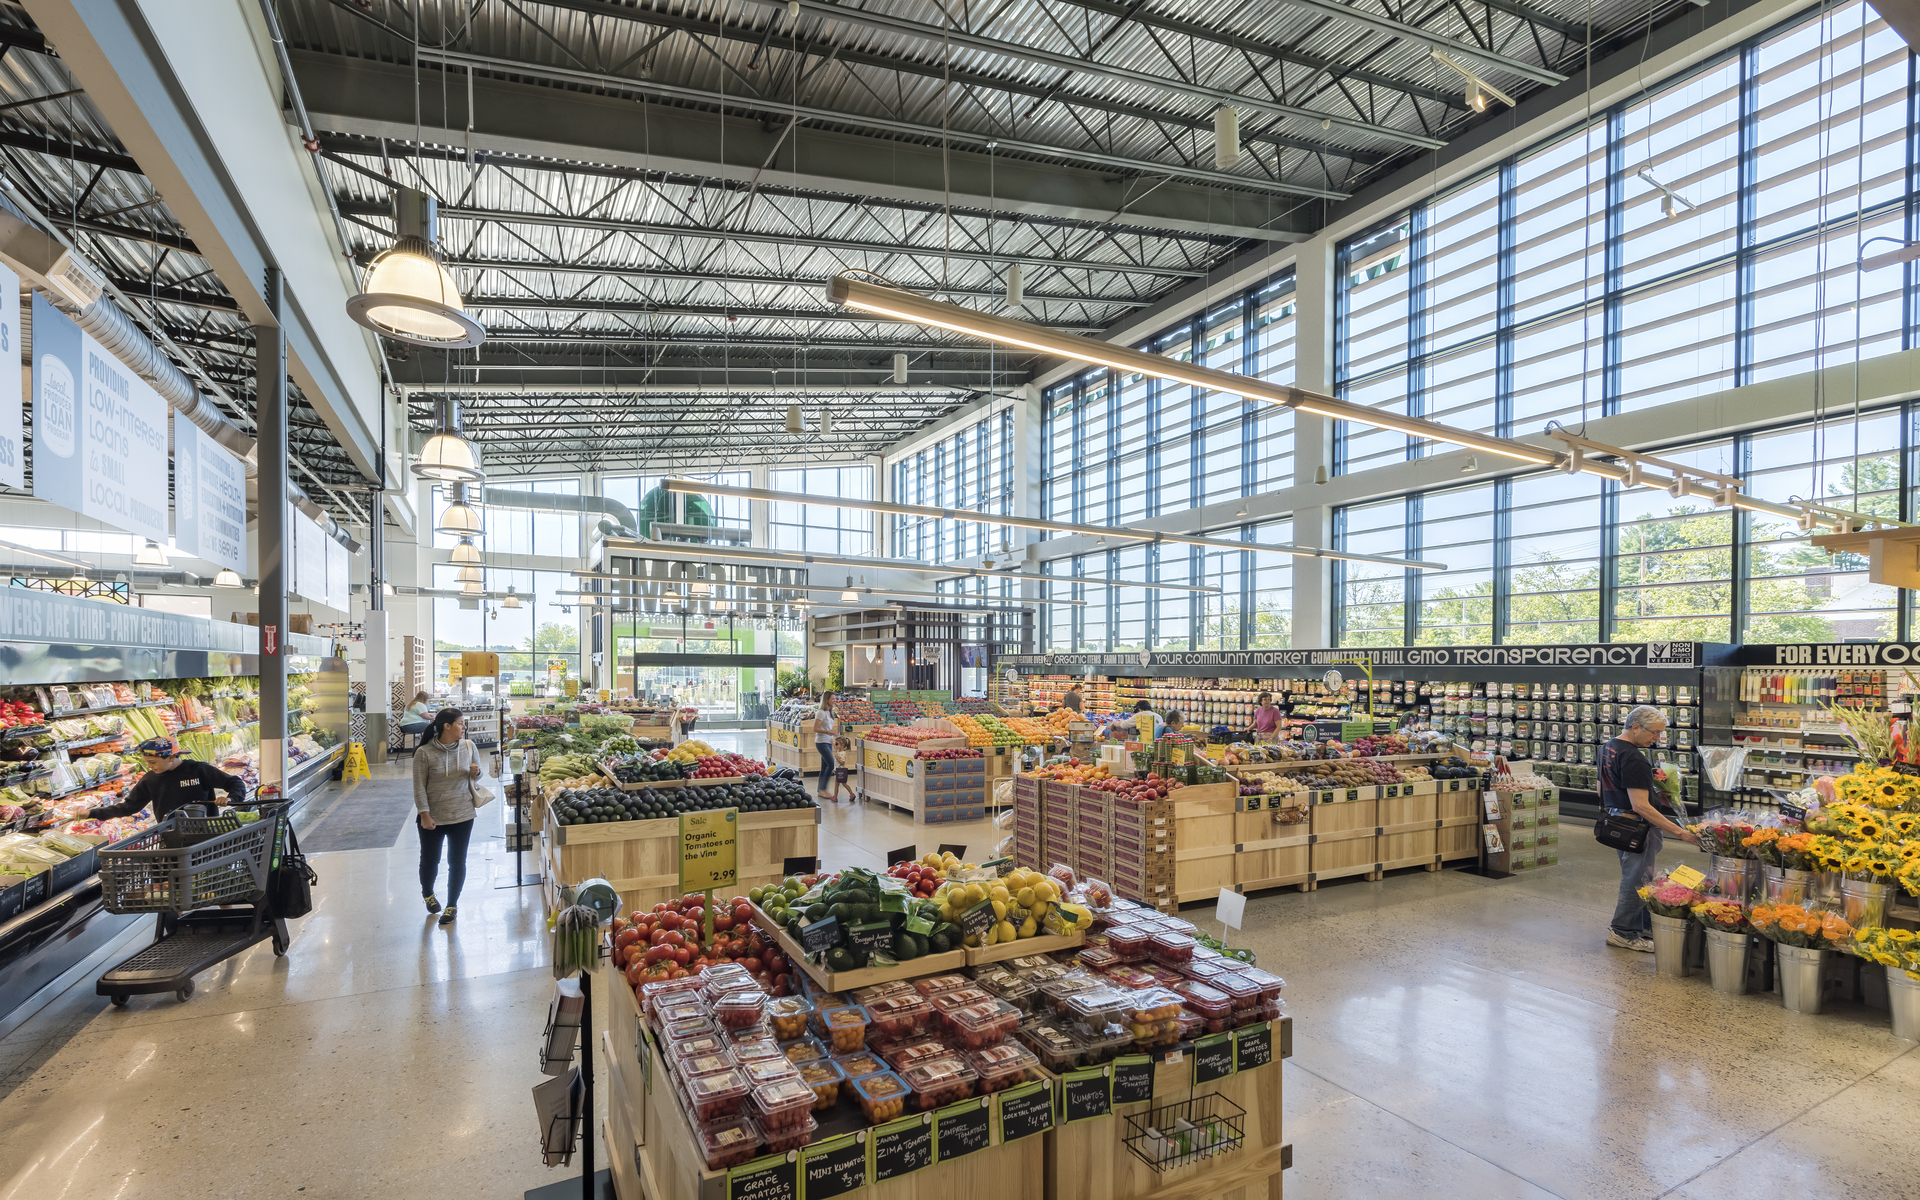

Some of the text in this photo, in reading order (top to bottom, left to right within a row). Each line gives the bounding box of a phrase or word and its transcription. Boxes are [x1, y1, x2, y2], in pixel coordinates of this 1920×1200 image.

[89, 351, 129, 402] PROVIDING
[44, 387, 72, 412] PRODUCER
[44, 399, 72, 433] LOAN
[47, 424, 70, 442] PROGRAM
[90, 448, 125, 486] to SMALL
[200, 442, 230, 480] COLLABORATING
[200, 464, 219, 490] IMPROVE
[130, 497, 164, 531] PRODUCERS
[202, 486, 222, 513] EDUCATION
[226, 501, 244, 526] NUTRITION
[206, 511, 214, 528] THE
[214, 514, 240, 542] COMMUNITIES
[46, 602, 70, 638] ARE
[72, 606, 140, 642] THIRD-PARTY
[141, 616, 178, 646] CERTIFIED
[180, 621, 193, 646] FOR
[1087, 654, 1102, 664] ITEMS
[1104, 654, 1140, 664] FARM TO TABLE
[1155, 653, 1183, 664] YOUR
[1311, 650, 1366, 664] COMMITTED
[1368, 650, 1380, 664] TO
[1382, 650, 1404, 664] FULL
[1776, 645, 1812, 664] FOR
[1816, 644, 1880, 664] EVERY
[777, 730, 788, 744] Sale
[876, 752, 894, 772] Sale
[690, 816, 707, 826] Sale
[685, 830, 717, 841] Organic
[685, 840, 723, 850] Tomatoes
[685, 850, 718, 860] the Vine
[710, 869, 735, 881] $2.99
[1241, 1042, 1268, 1055] TOMATOES
[1244, 1038, 1260, 1048] GRAPE
[1197, 1054, 1221, 1066] CAMPARI
[1122, 1080, 1150, 1088] TOMATOES
[1071, 1090, 1104, 1105] KUMATOS
[1003, 1100, 1052, 1120] COCKTAIL TOMATOES
[938, 1123, 970, 1139] CAMPARI
[955, 1123, 987, 1140] TOMATOES
[876, 1134, 899, 1146] CANADA
[877, 1130, 932, 1159] ZIMA TOMATOES
[805, 1154, 828, 1164] CANADA
[904, 1147, 927, 1168] $3.99
[810, 1154, 866, 1181] MINI KUMATOS
[878, 1168, 892, 1179] PINT
[737, 1182, 790, 1200] TOMATOES
[744, 1174, 779, 1192] GRAPE
